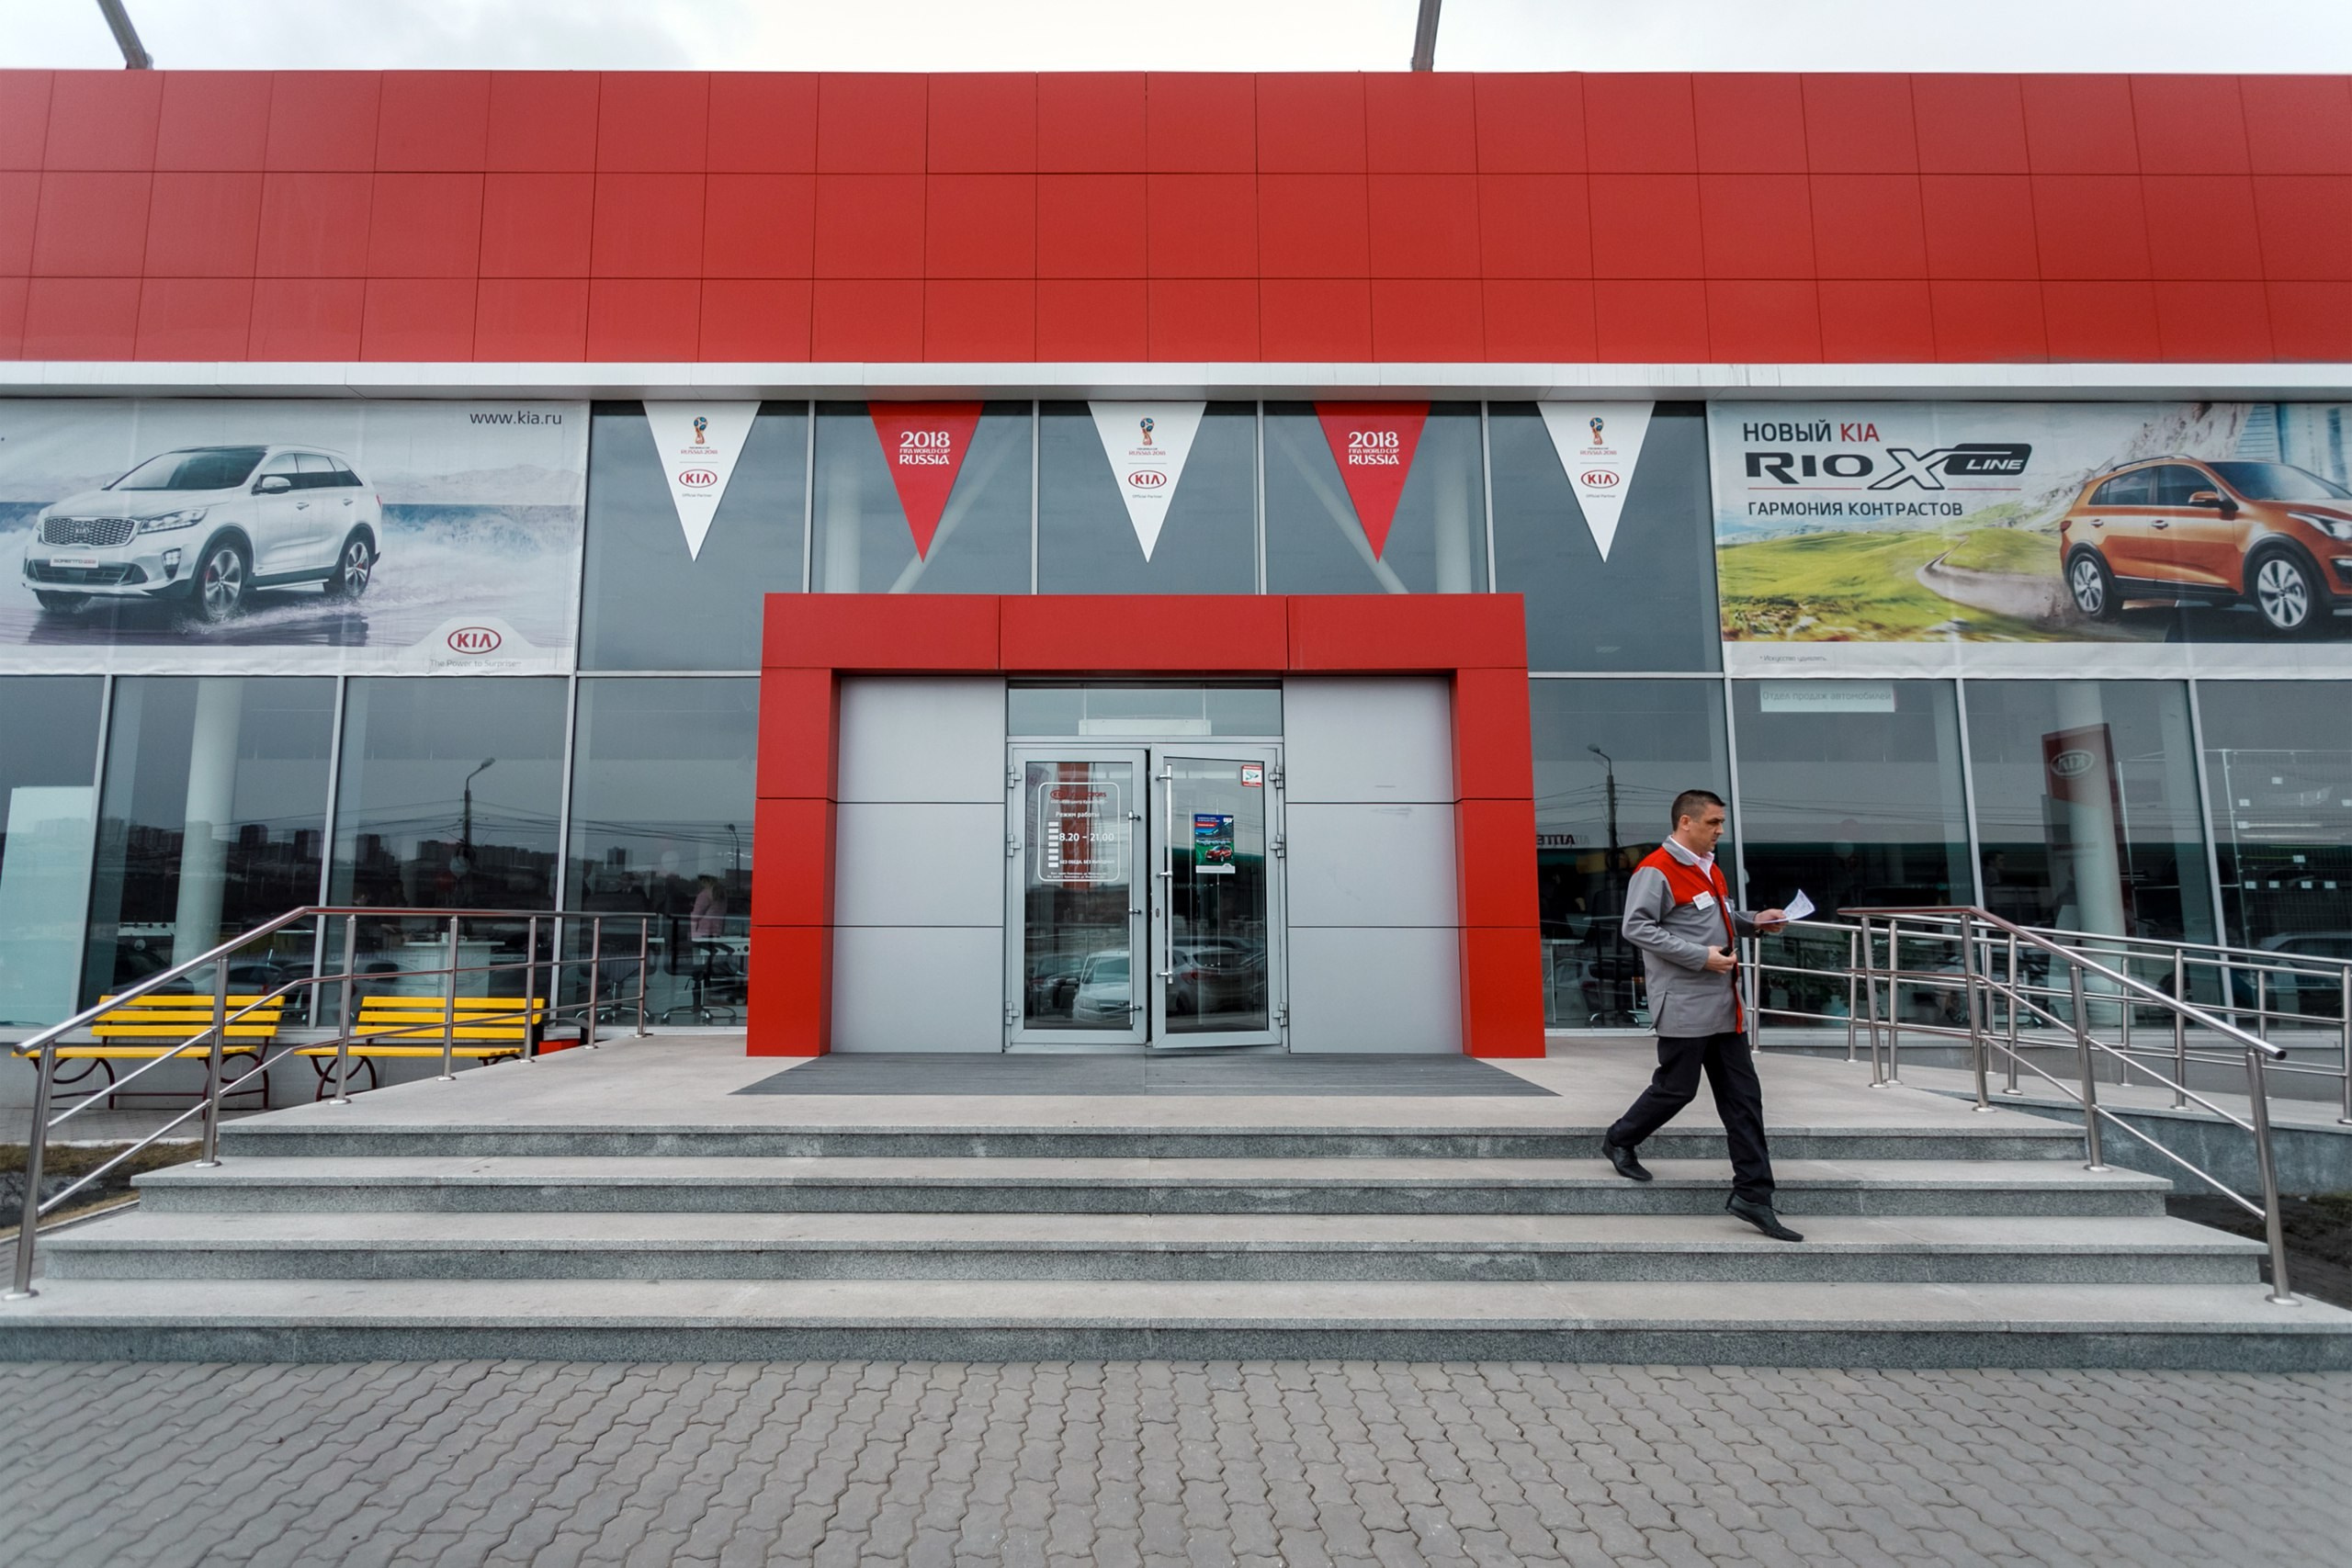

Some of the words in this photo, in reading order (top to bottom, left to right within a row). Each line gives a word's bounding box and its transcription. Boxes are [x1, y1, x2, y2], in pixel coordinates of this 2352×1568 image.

[469, 411, 562, 425] www.kia.ru
[1743, 419, 1832, 442] НОВЫЙ
[1840, 423, 1881, 443] KIA
[899, 431, 951, 448] 2018
[1348, 431, 1399, 448] 2018
[899, 454, 950, 465] RUSSIA
[1348, 454, 1400, 465] RUSSIA
[1745, 452, 1873, 484] RIO
[1965, 458, 2024, 470] LINE
[1747, 502, 1843, 516] ГАРМОНИЯ
[1848, 502, 1963, 516] КОНТРАСТОВ
[447, 660, 471, 668] Power
[1762, 692, 1791, 701] Отдел
[1792, 693, 1827, 701] продаж
[1829, 691, 1893, 700] автомобилей
[1058, 832, 1080, 841] 8.20
[1090, 832, 1115, 842] 21.00
